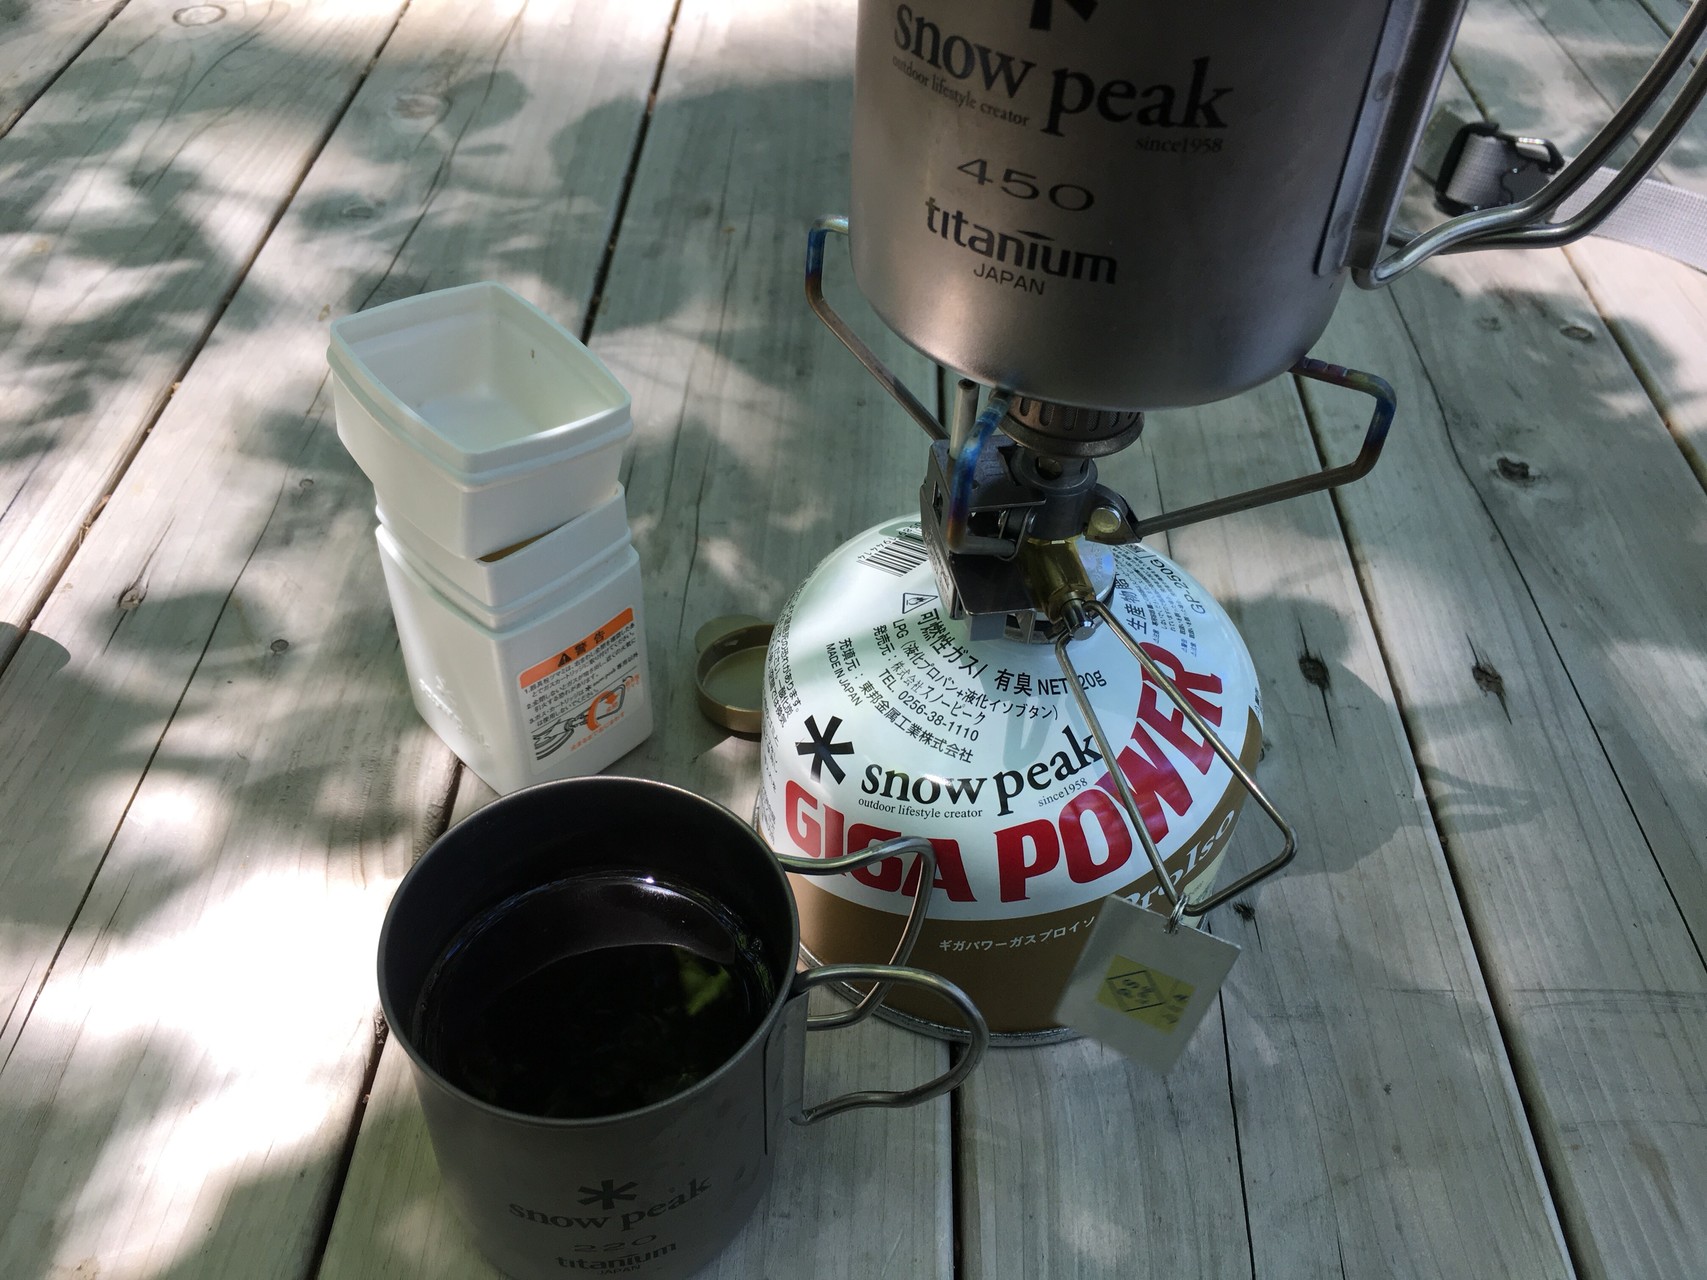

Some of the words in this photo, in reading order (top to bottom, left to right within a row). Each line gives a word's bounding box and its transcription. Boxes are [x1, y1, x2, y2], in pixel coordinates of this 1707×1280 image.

[892, 56, 929, 87] outdoor
[931, 76, 977, 110] lifestyle
[979, 101, 1031, 128] creator
[894, 4, 1037, 99] snow
[1040, 55, 1234, 137] peak
[1135, 134, 1223, 153] since1958
[957, 158, 1095, 212] 450
[973, 262, 1046, 296] JAPAN
[1150, 558, 1206, 615] GP-250G
[892, 618, 910, 640] LPG
[826, 642, 841, 669] MADE
[838, 677, 863, 707] JAPAN
[993, 668, 1034, 697] 有臭
[1037, 677, 1069, 696] NET
[878, 667, 896, 694] TEL.
[897, 689, 980, 743] 0256-38-1110
[785, 779, 978, 903] GIGA
[993, 641, 1223, 903] POWER
[861, 763, 988, 805] snow
[993, 724, 1103, 817] peak
[1037, 777, 1088, 807] since1958
[858, 798, 896, 815] outdoor
[898, 804, 941, 820] lifestyle
[944, 809, 983, 819] creator
[508, 1202, 612, 1230] snow
[620, 1176, 713, 1232] peak
